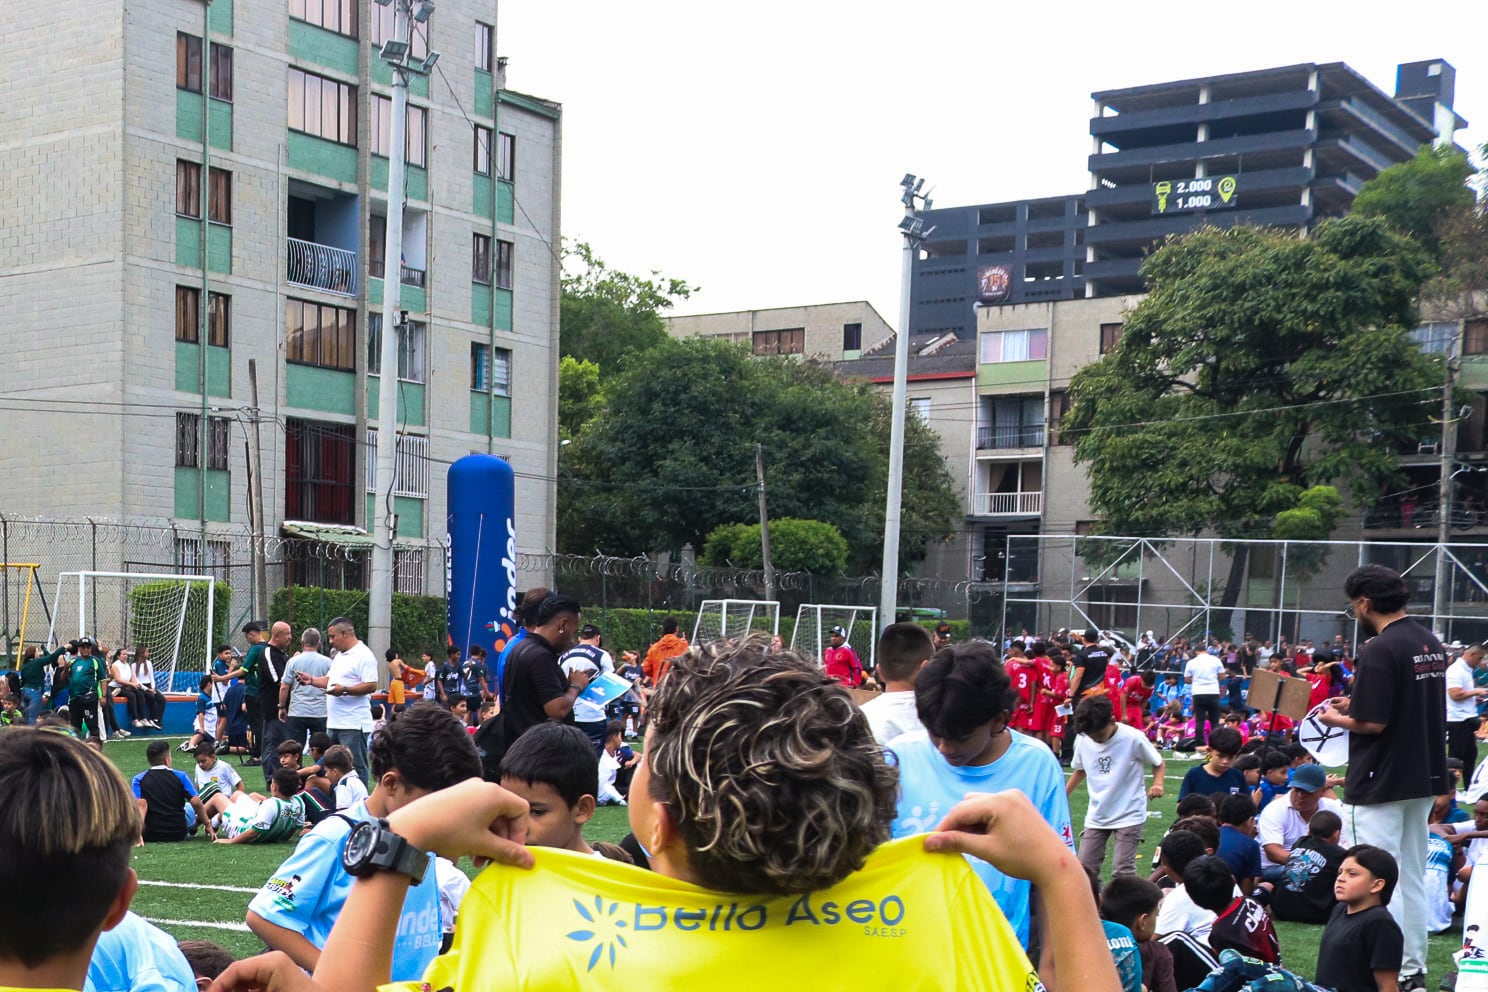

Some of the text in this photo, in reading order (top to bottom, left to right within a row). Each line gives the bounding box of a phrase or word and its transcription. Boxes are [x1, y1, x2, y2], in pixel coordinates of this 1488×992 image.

[1177, 179, 1212, 193] 2.000
[1176, 195, 1211, 209] 1.000
[634, 895, 905, 931] Bello Aseo
